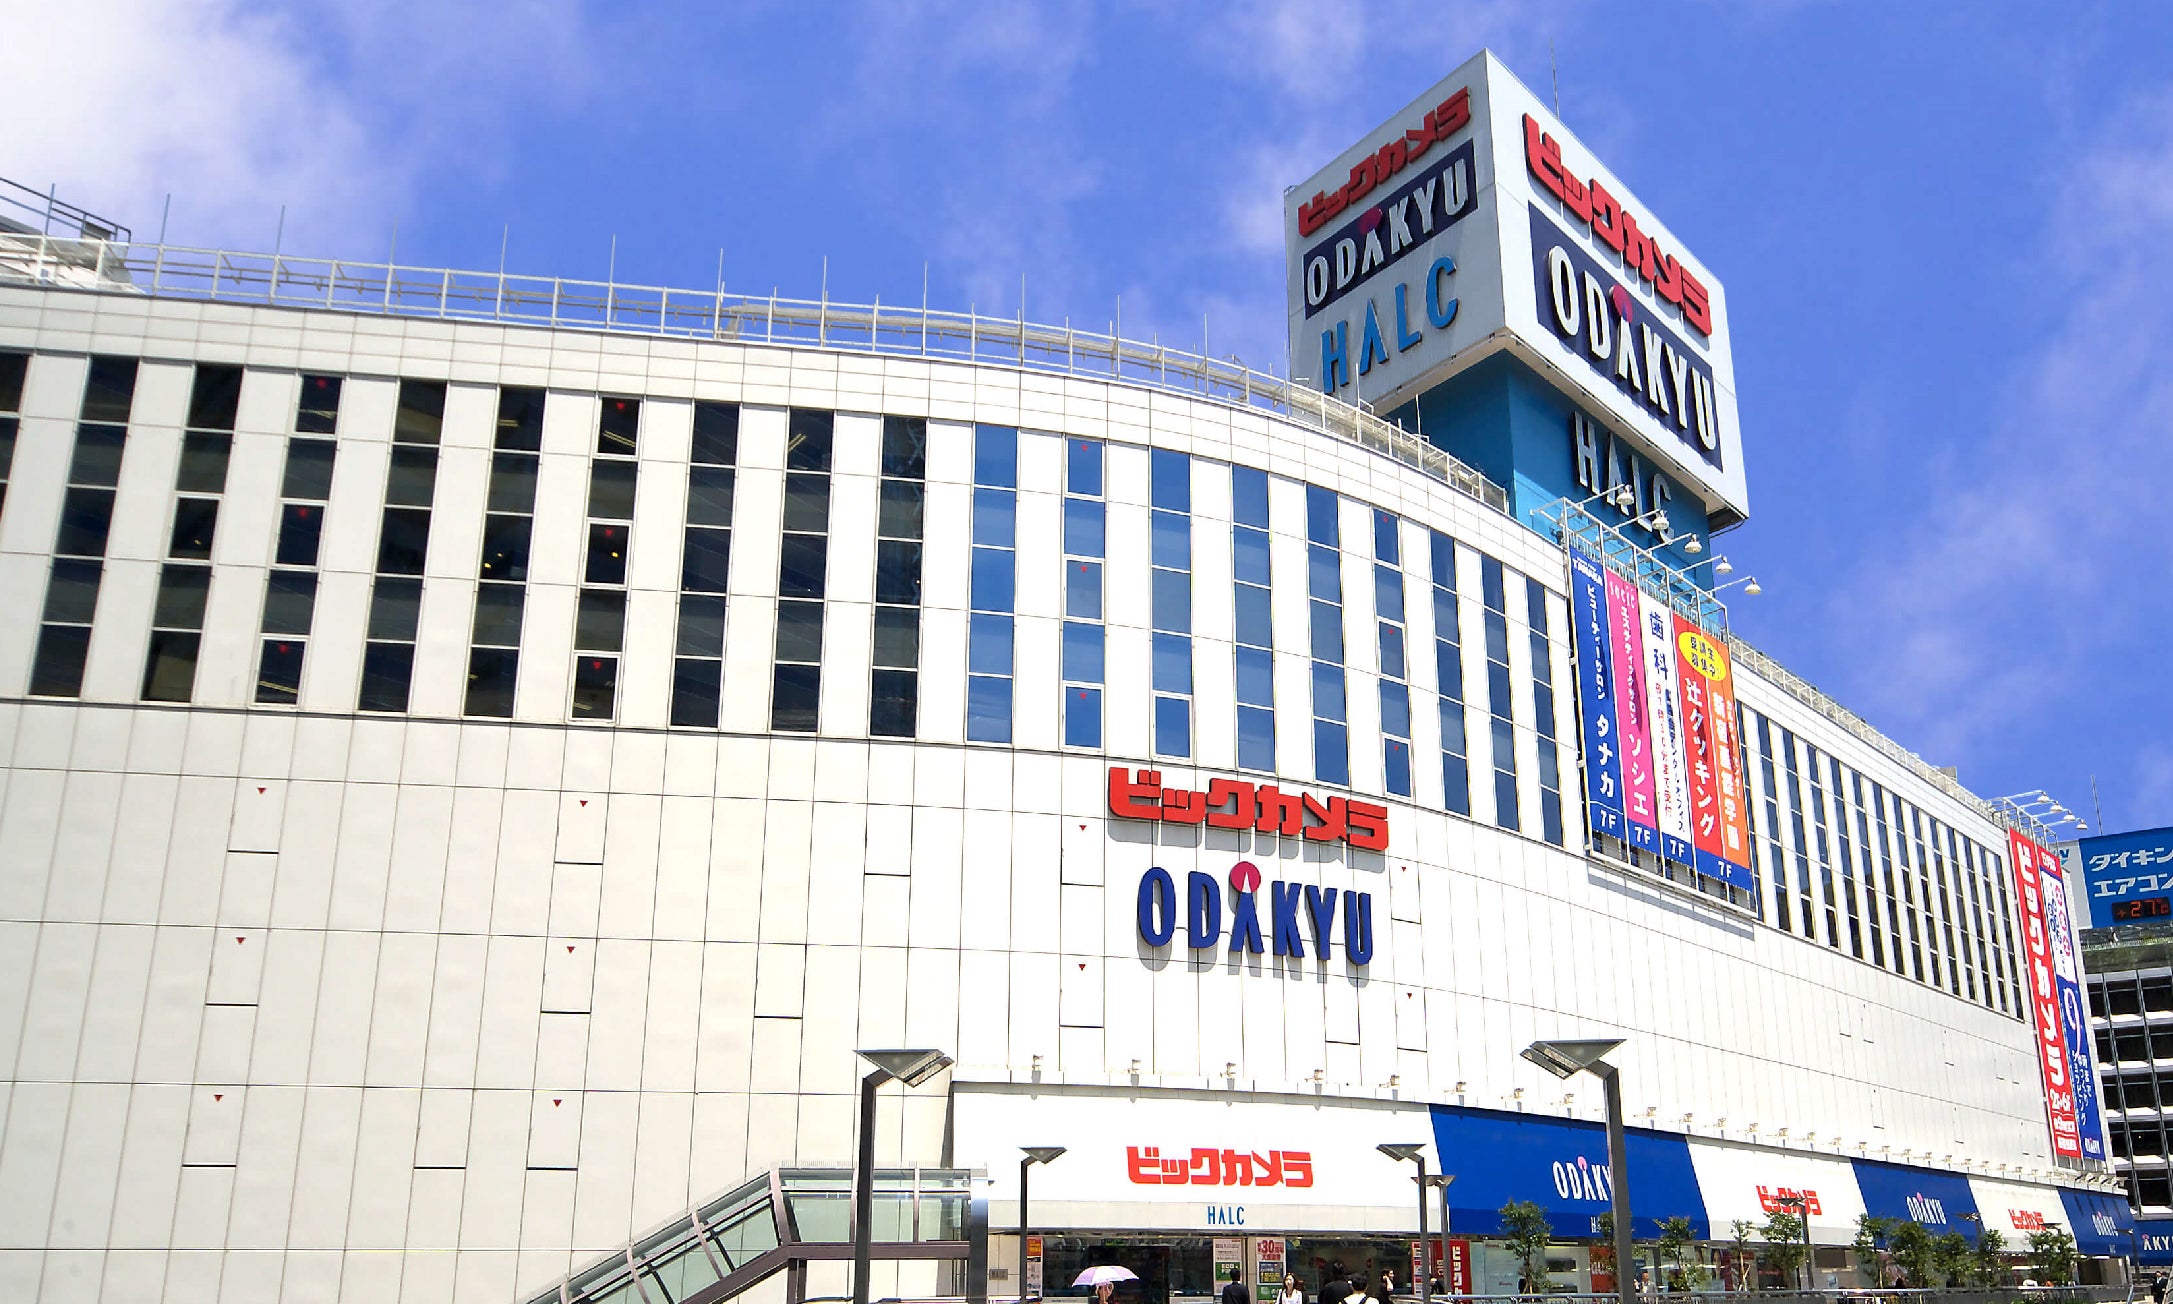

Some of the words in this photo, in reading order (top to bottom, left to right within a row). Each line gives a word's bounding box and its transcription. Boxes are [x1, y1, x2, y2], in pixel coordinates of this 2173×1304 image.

[1299, 87, 1470, 238] ビックカメラ
[1307, 157, 1468, 306] ODAKYU
[1522, 113, 1712, 337] ビックカメラ
[1321, 256, 1459, 394] HALC
[1548, 245, 1718, 450] ODAKYU
[1575, 410, 1674, 545] HALC
[1650, 611, 1668, 680] 歯科
[1596, 714, 1615, 798] タナカ
[1629, 733, 1649, 816] ソシエ
[1685, 677, 1715, 837] 辻クッキング
[1108, 767, 1389, 851] ビックカメラ
[1600, 810, 1617, 830] 7F
[1634, 826, 1651, 845] 7F
[1669, 839, 1685, 858] 7F
[1718, 860, 1733, 879] 7F
[2088, 847, 2173, 872] ダイキン
[1137, 861, 1374, 966] ODAKYU
[2016, 841, 2065, 1087] ビックカメラ
[1126, 1146, 1313, 1188] ビックカメラ
[1756, 1185, 1823, 1216] ビックカメラ
[1906, 1191, 1947, 1225] ODAKYU
[1207, 1205, 1245, 1226] HALC
